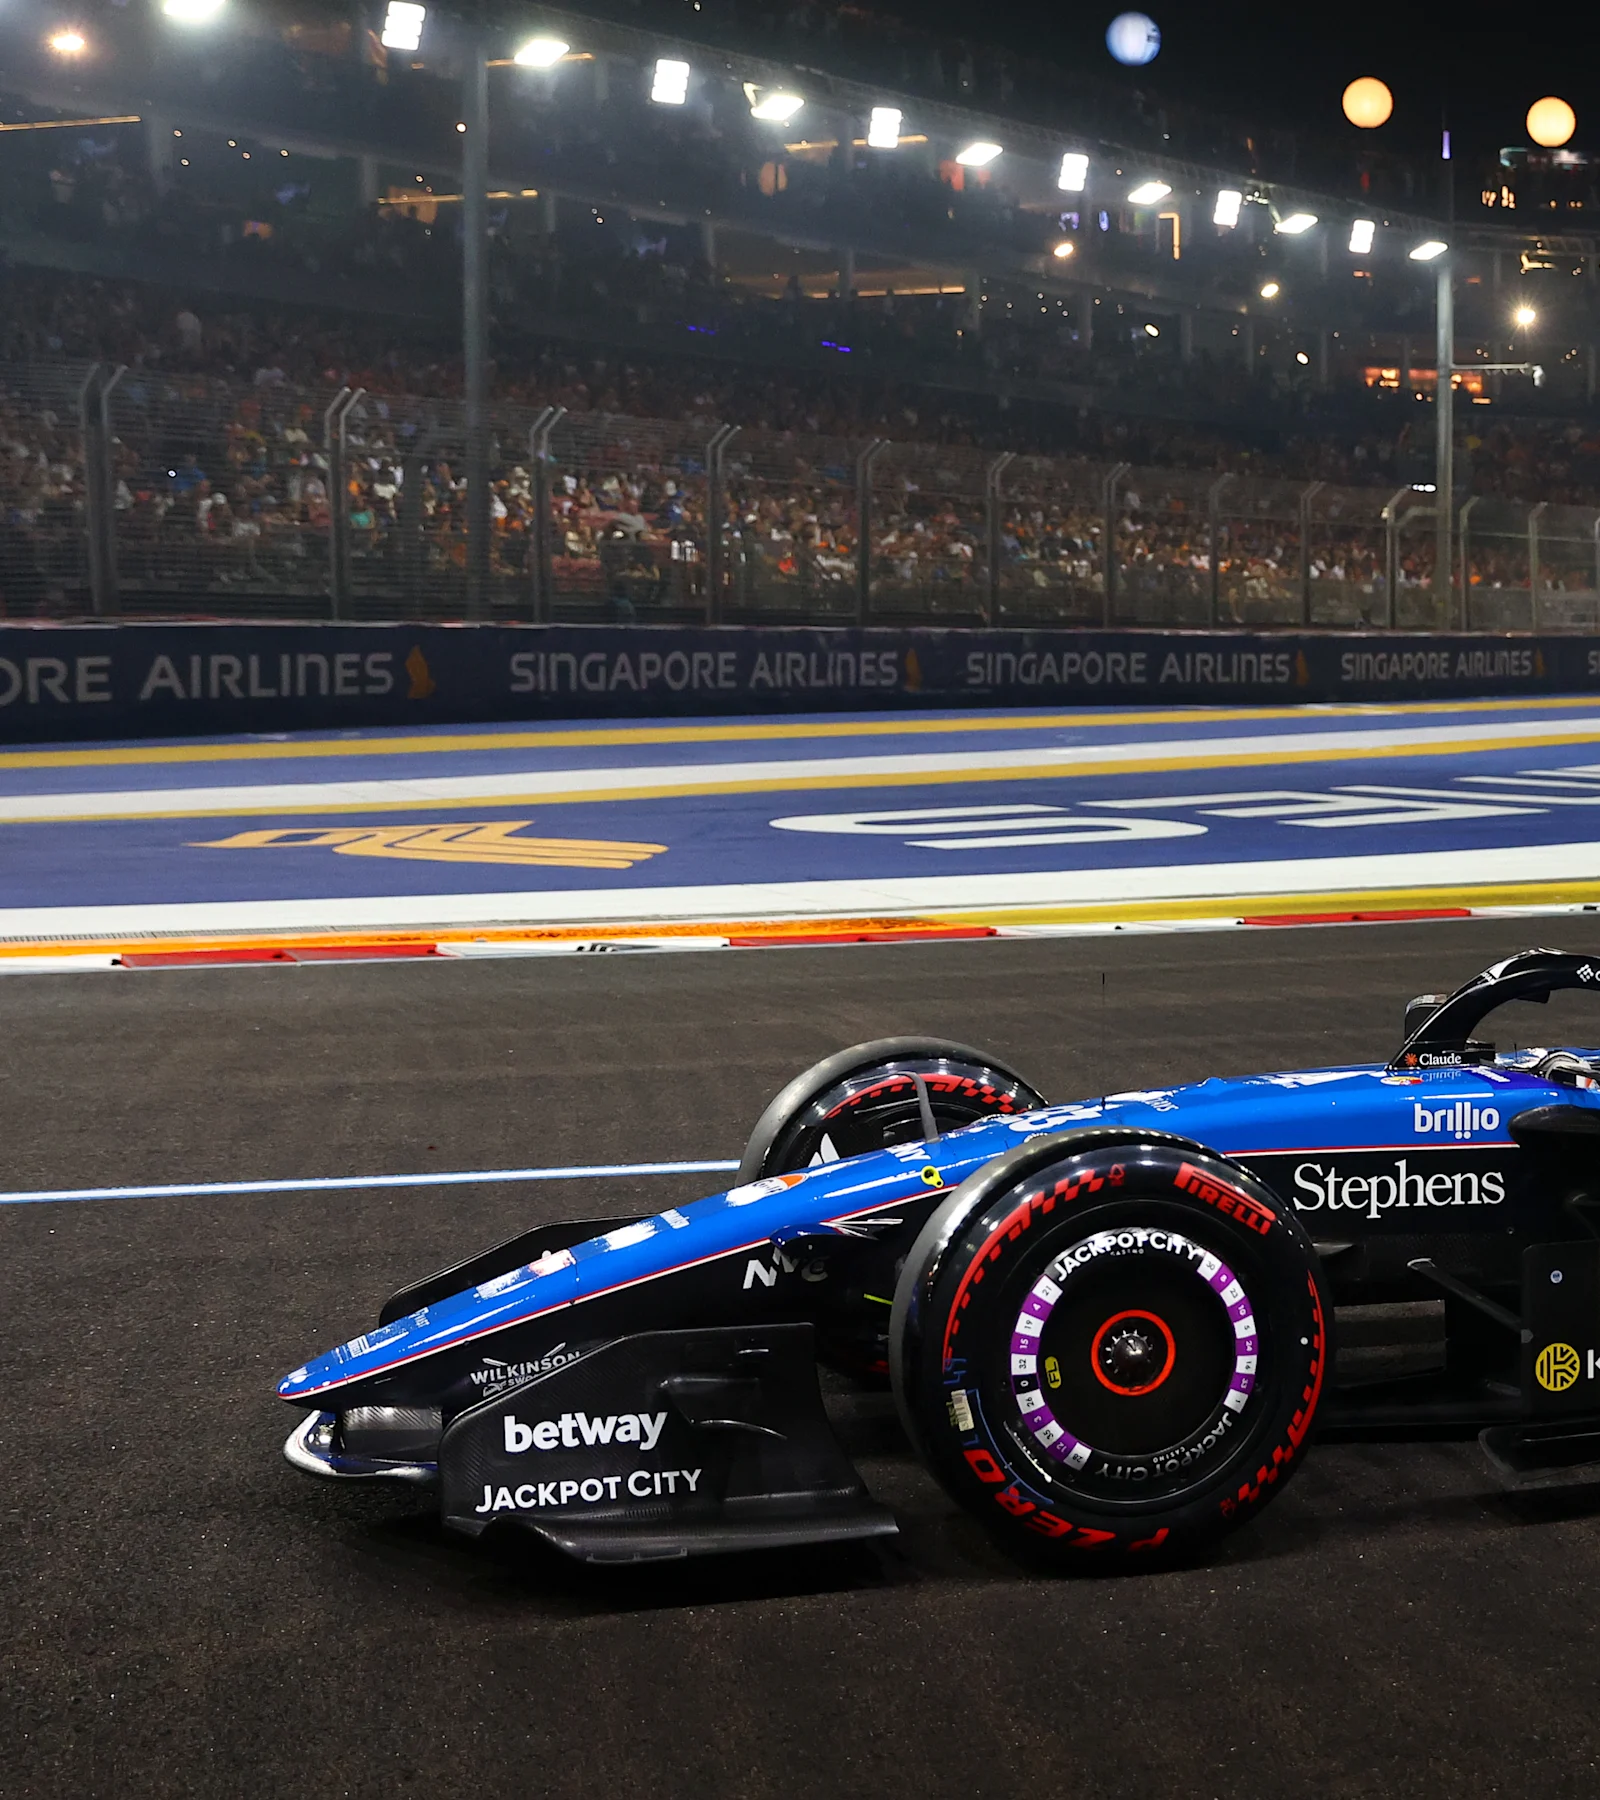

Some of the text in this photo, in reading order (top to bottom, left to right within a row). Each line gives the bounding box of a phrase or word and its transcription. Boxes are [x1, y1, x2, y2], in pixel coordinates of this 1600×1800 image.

[140, 653, 393, 699] AIRLINES
[509, 651, 898, 692] SINGAPORE AIRLINES
[966, 651, 1290, 685] SINGAPORE AIRLINES
[1340, 650, 1533, 681] SINGAPORE AIRLINES
[1419, 1053, 1462, 1066] Claude
[1173, 1162, 1276, 1236] PIRELLI
[1293, 1158, 1505, 1219] Stephens
[1054, 1232, 1201, 1282] JACKPOT CITY
[1041, 1285, 1052, 1297] 21
[1023, 1319, 1033, 1330] 19
[1238, 1304, 1247, 1316] 10
[1019, 1338, 1029, 1349] 15
[469, 1351, 581, 1385] WILKINSON
[1019, 1358, 1027, 1369] 32
[1026, 1396, 1035, 1408] 26
[503, 1411, 669, 1453] betway
[1042, 1429, 1054, 1440] 35
[1153, 1411, 1233, 1477] JACKPOT
[474, 1468, 703, 1514] JACKPOT CITY
